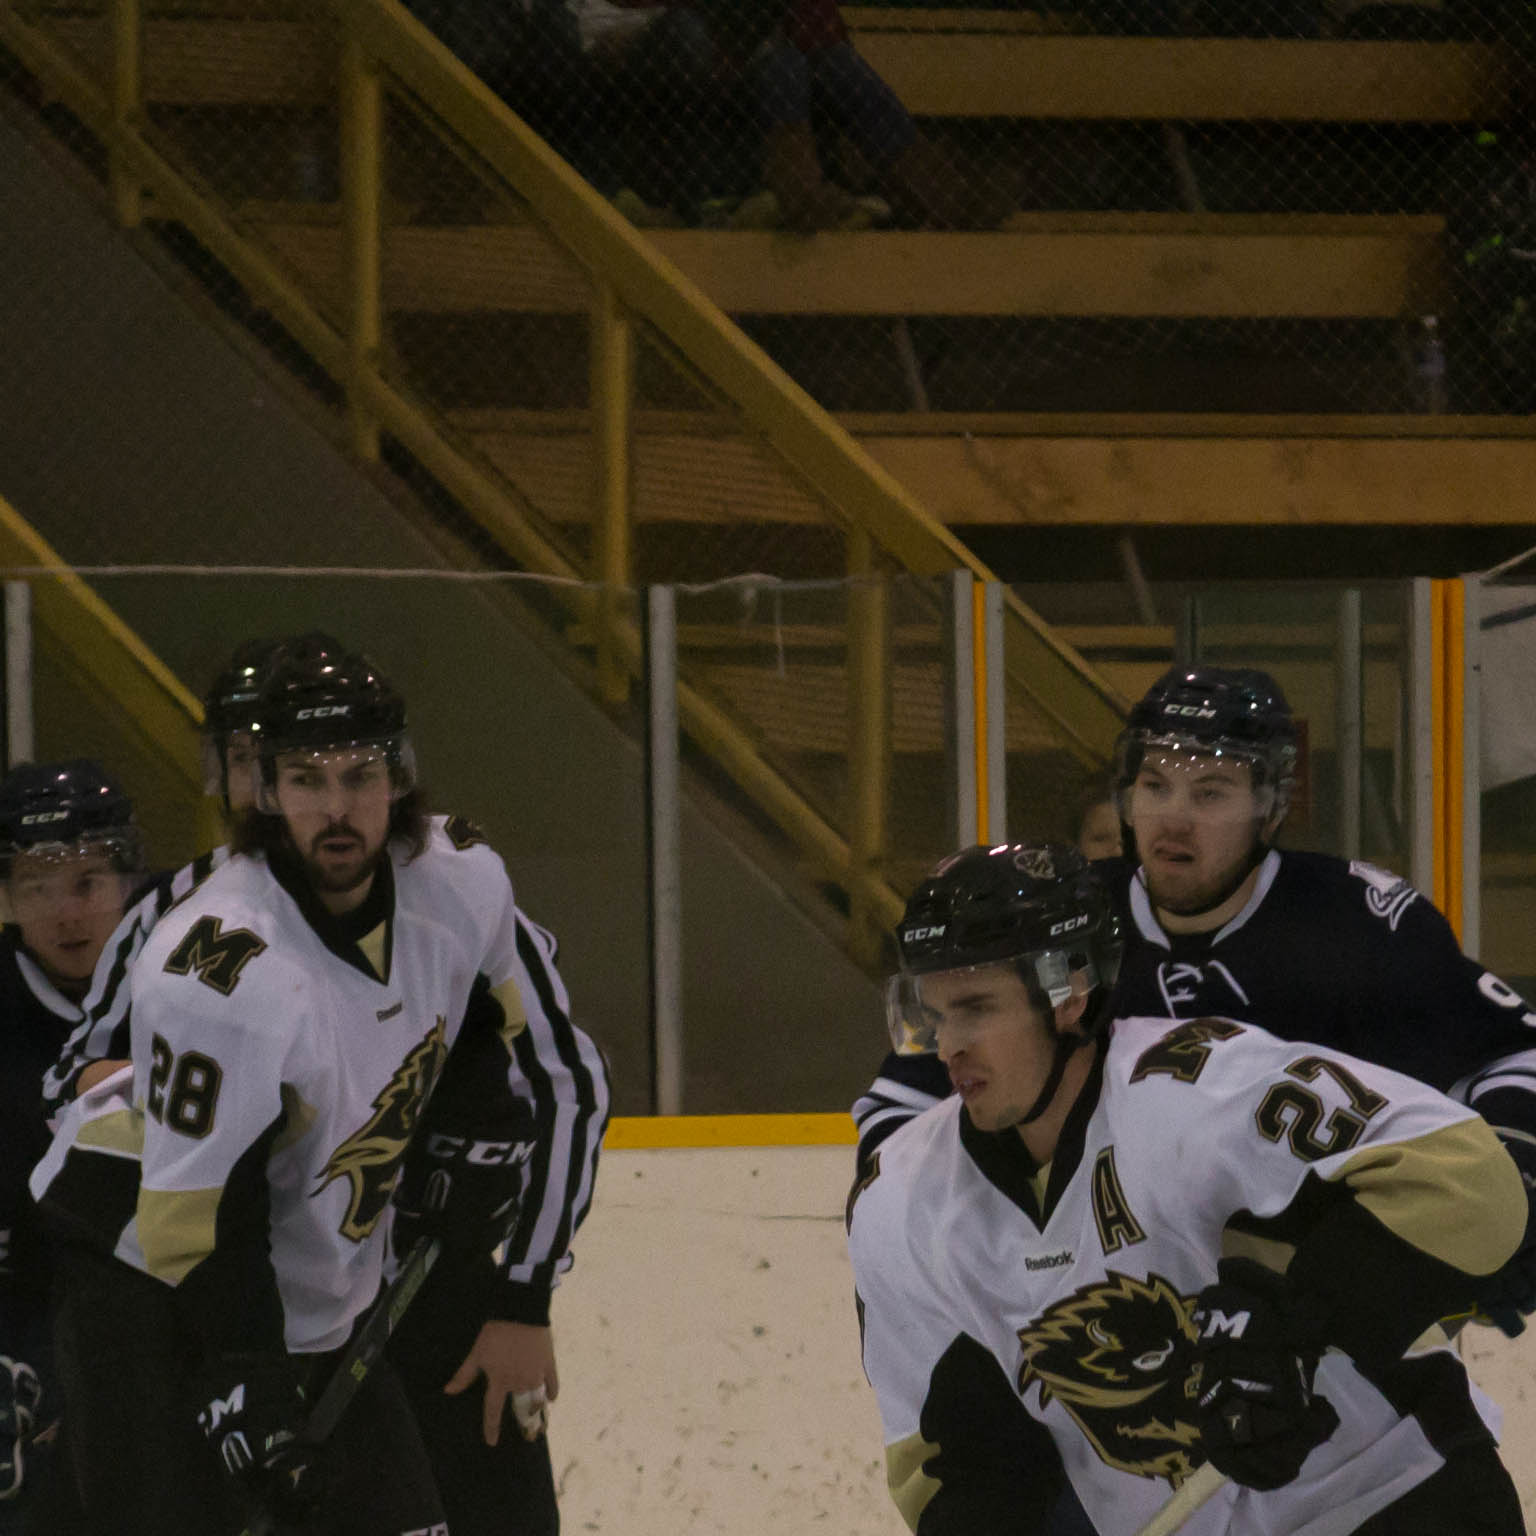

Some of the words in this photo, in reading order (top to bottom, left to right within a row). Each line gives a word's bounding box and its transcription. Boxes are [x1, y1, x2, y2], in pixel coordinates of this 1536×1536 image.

[1164, 704, 1217, 718] CCM
[904, 925, 946, 942] CCM
[1050, 913, 1089, 936] CCM
[163, 914, 267, 996] M
[148, 1031, 223, 1139] 28
[1255, 1055, 1389, 1162] 27
[427, 1134, 537, 1165] CCM
[1091, 1145, 1147, 1256] A
[1025, 1251, 1075, 1271] Reebok
